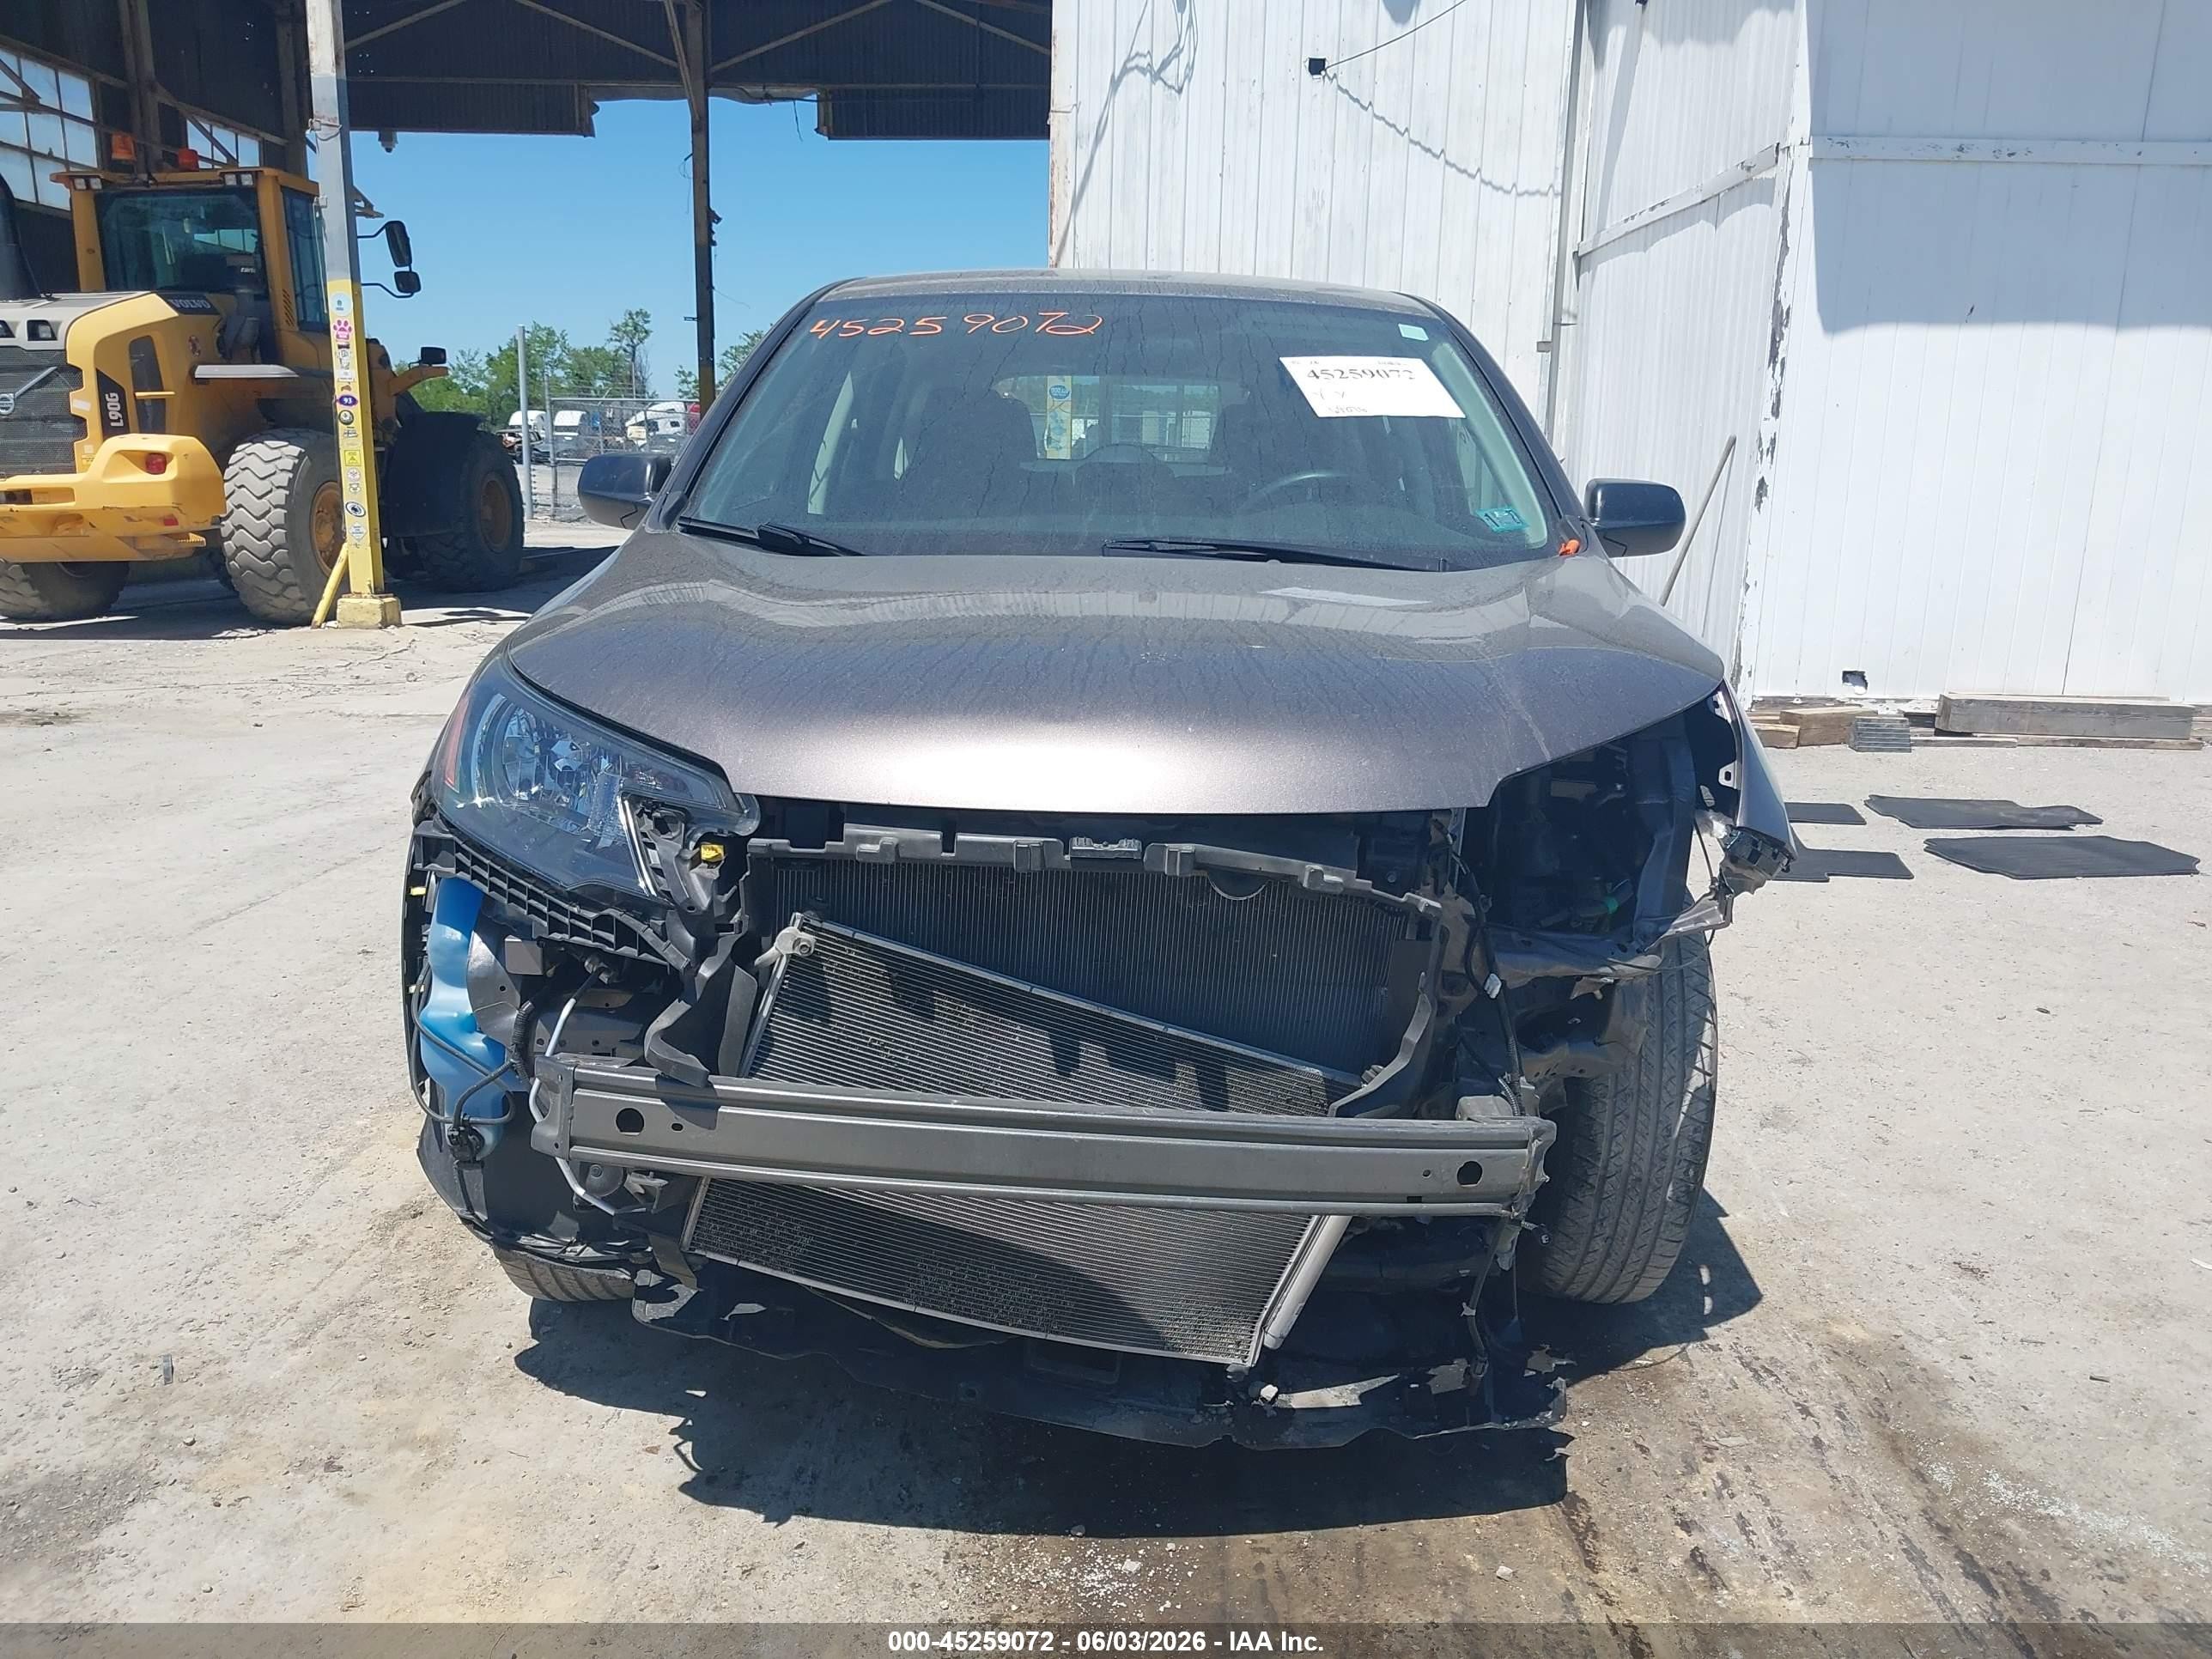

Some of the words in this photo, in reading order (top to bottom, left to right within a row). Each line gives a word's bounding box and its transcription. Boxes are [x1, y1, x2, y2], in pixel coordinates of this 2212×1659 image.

[167, 299, 211, 308] VOLVO
[810, 312, 1103, 339] 45259072
[105, 392, 125, 427] L90G
